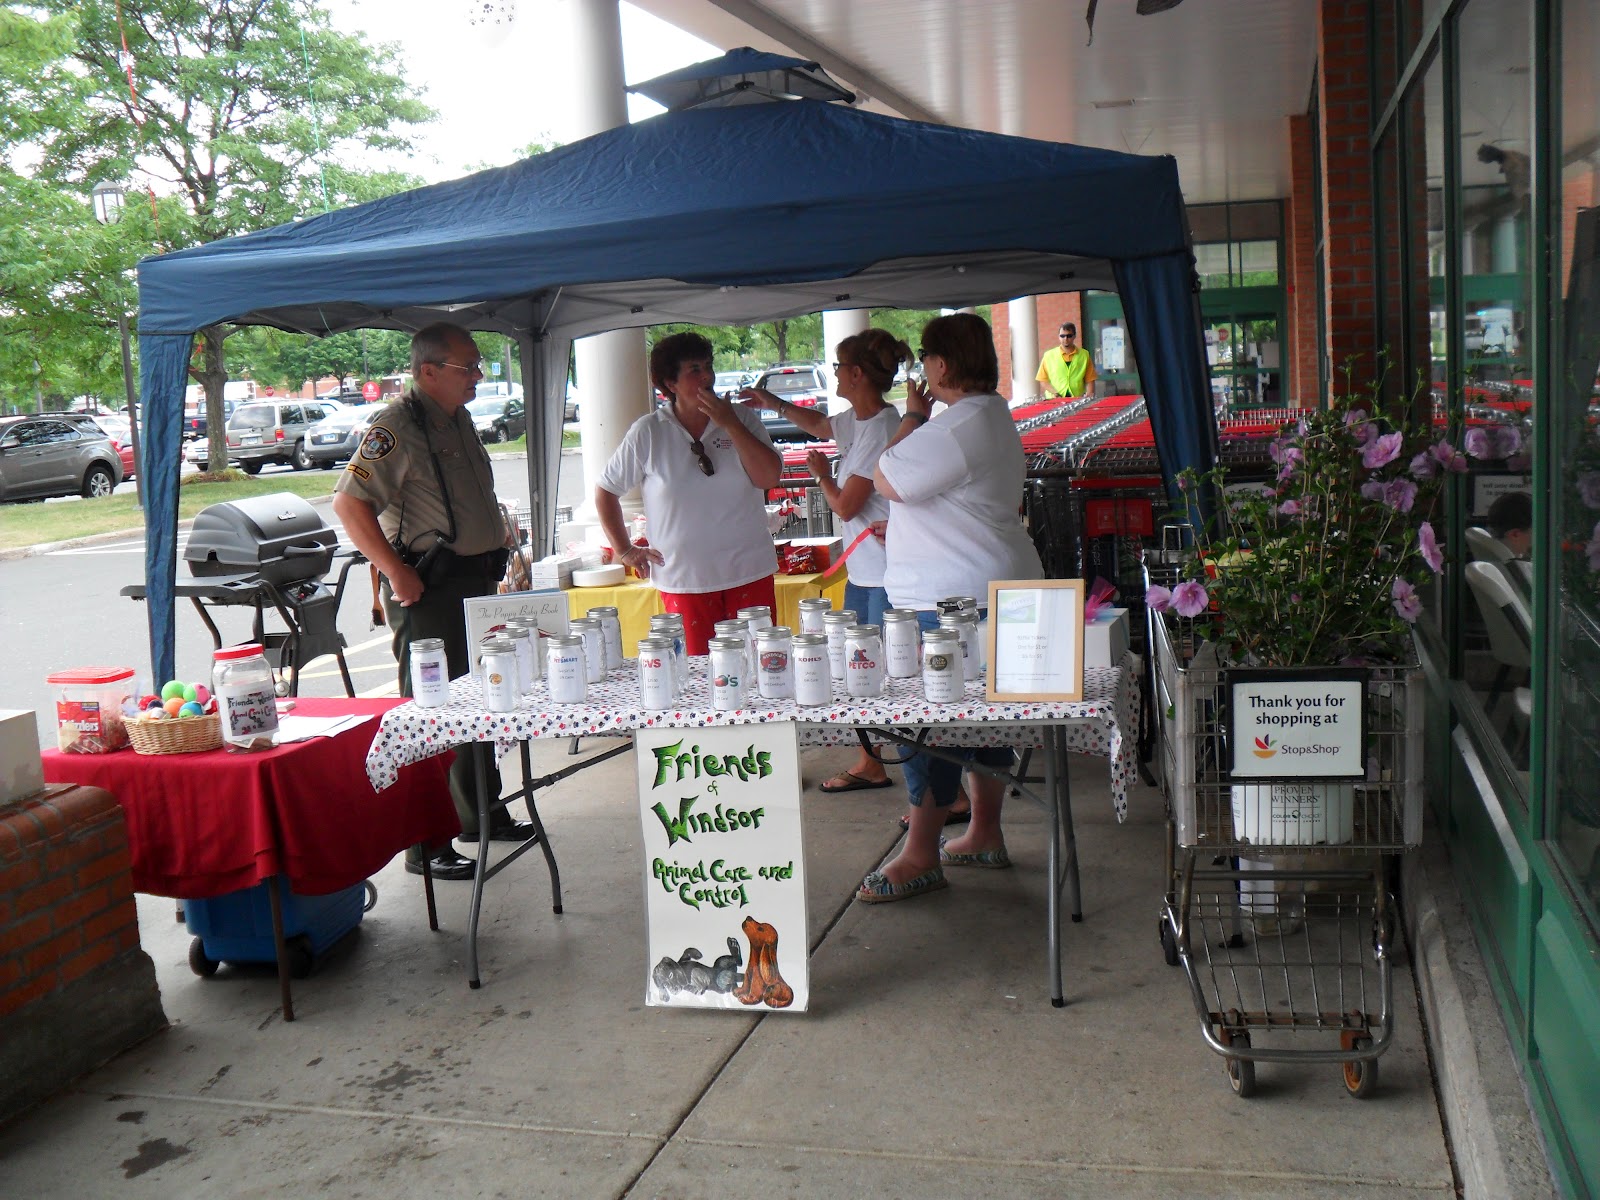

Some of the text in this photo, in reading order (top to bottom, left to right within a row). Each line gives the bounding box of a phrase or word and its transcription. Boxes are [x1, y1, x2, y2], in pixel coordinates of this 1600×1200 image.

[478, 607, 492, 618] The
[519, 604, 538, 617] Baby
[540, 603, 559, 615] Book
[643, 658, 662, 669] CVS
[848, 661, 876, 670] PETCO
[1249, 694, 1346, 710] Thank you for
[1256, 712, 1338, 728] shopping at
[1281, 744, 1340, 756] Stop&Shop
[651, 738, 773, 790] Friends
[707, 780, 718, 796] of
[1274, 786, 1314, 795] PROVEN
[1272, 795, 1319, 804] WINNERS
[650, 794, 765, 849] Windsor
[652, 857, 793, 892] Animal Care and
[678, 882, 750, 911] Control
